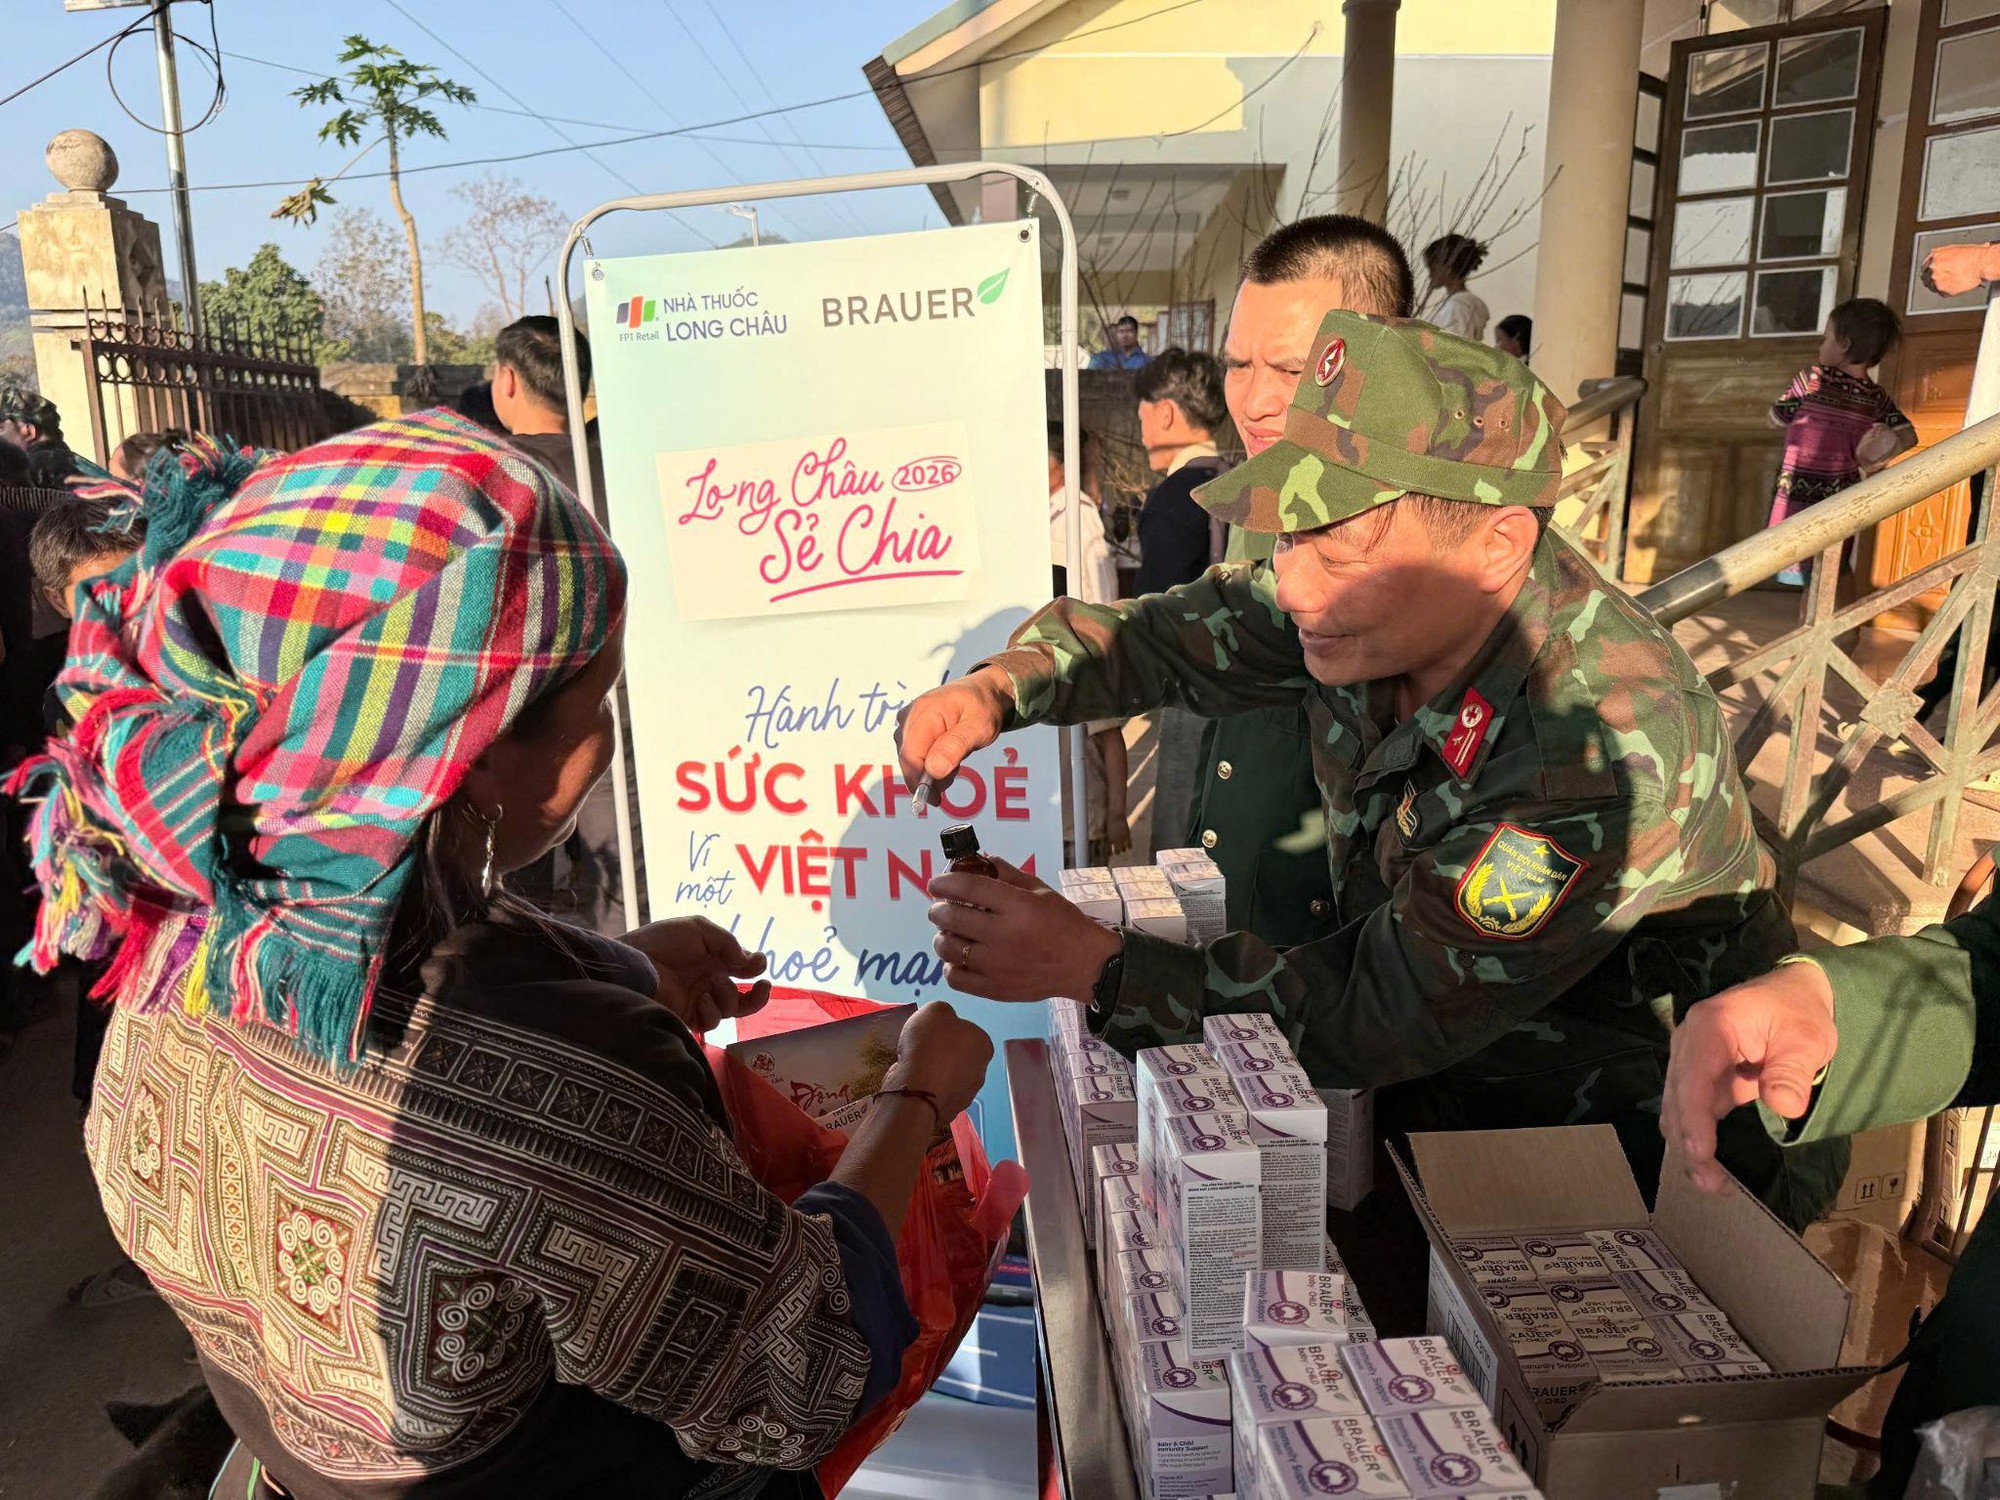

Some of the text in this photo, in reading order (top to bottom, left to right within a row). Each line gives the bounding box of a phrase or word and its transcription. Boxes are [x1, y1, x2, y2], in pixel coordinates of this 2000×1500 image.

[663, 286, 758, 314] NHÀ THUỐC
[822, 287, 976, 328] BRAUER
[619, 331, 659, 342] FPT Retail
[666, 310, 787, 342] LONG CHÂU
[678, 437, 956, 536] Long Châu 2026
[759, 497, 953, 584] Sẻ Chia
[745, 677, 855, 749] Hành
[675, 745, 808, 815] SỨC
[735, 828, 868, 913] VIỆT
[675, 870, 736, 909] một
[825, 1109, 863, 1131] RAUER
[1221, 1114, 1243, 1141] BRAUER
[1309, 1291, 1318, 1308] CHILD
[1318, 1275, 1333, 1316] BRAUER
[1579, 1305, 1634, 1314] BRAUER
[1504, 1311, 1558, 1321] BRAUER
[1576, 1325, 1632, 1335] BRAUER
[1508, 1330, 1554, 1340] RAUER
[1705, 1314, 1739, 1349] BRAUER
[1306, 1366, 1320, 1386] CHILD
[1308, 1345, 1339, 1393] BRAUER
[1419, 1358, 1435, 1378] CHILD
[1420, 1339, 1455, 1386] BRAUER
[1531, 1385, 1578, 1398] RAUER
[1344, 1418, 1381, 1472] BRAUER
[1461, 1410, 1501, 1464] BRAUER
[1462, 1434, 1480, 1456] CHILD
[1342, 1442, 1360, 1464] CHILD
